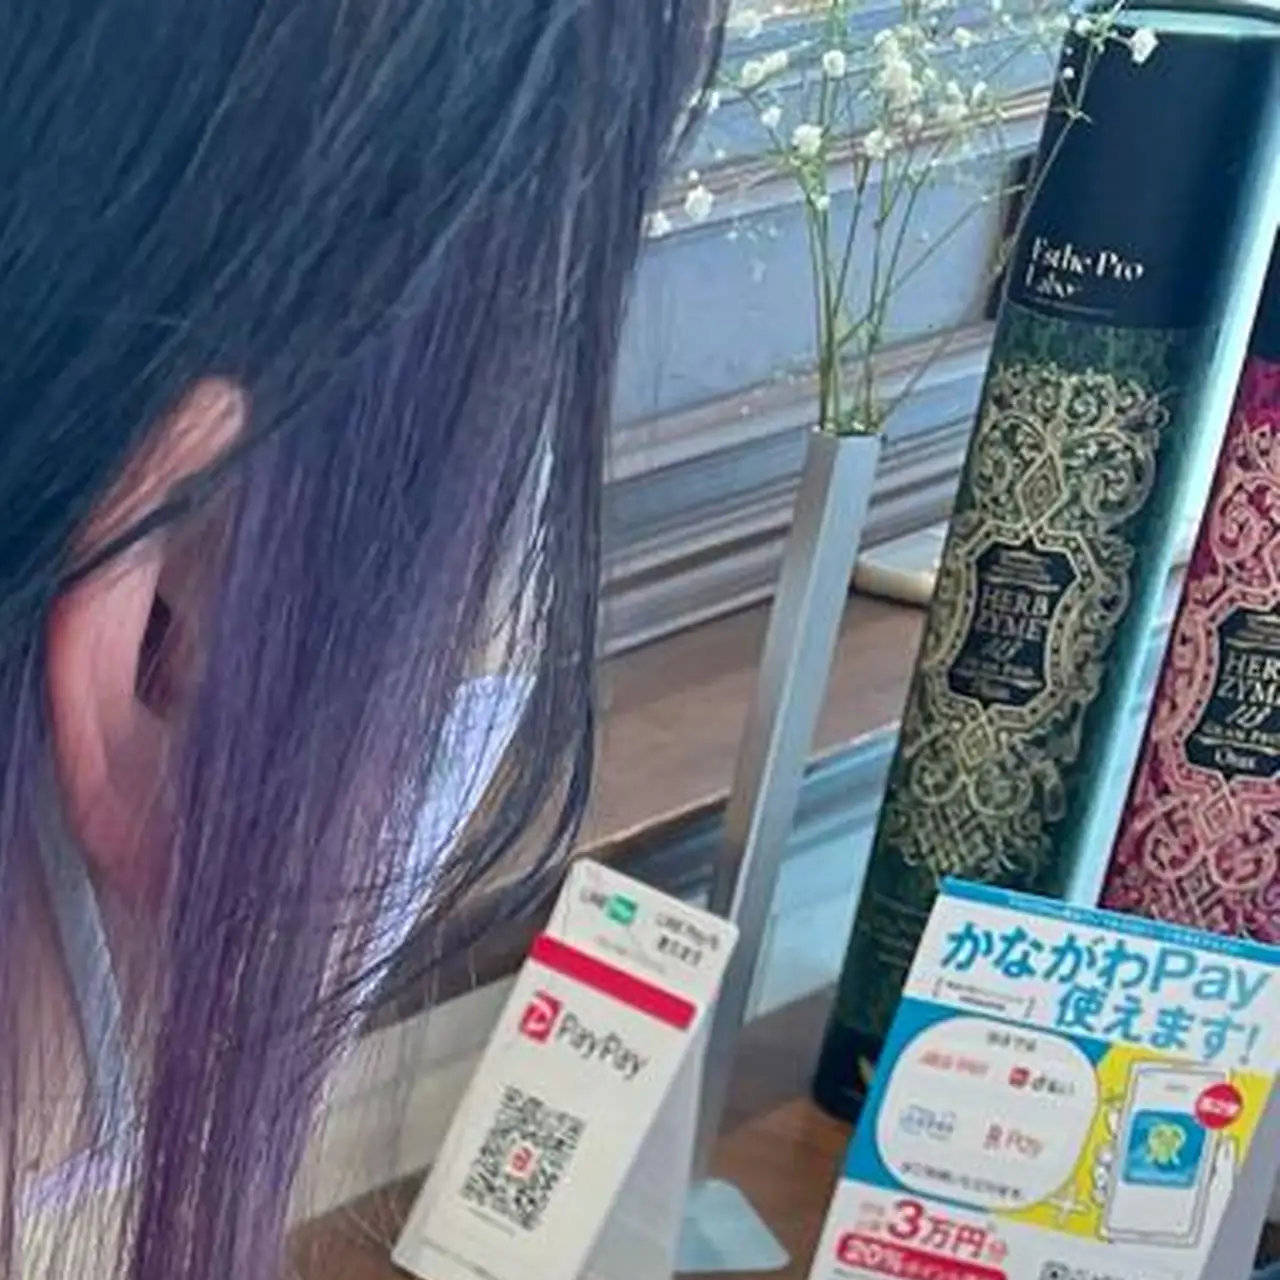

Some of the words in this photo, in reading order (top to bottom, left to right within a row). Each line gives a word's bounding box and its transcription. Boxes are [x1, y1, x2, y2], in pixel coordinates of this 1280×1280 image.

[1095, 251, 1145, 282] Pro
[979, 583, 1049, 617] HERB
[941, 921, 1272, 1010] かながわPay
[557, 1012, 650, 1082] PayPay
